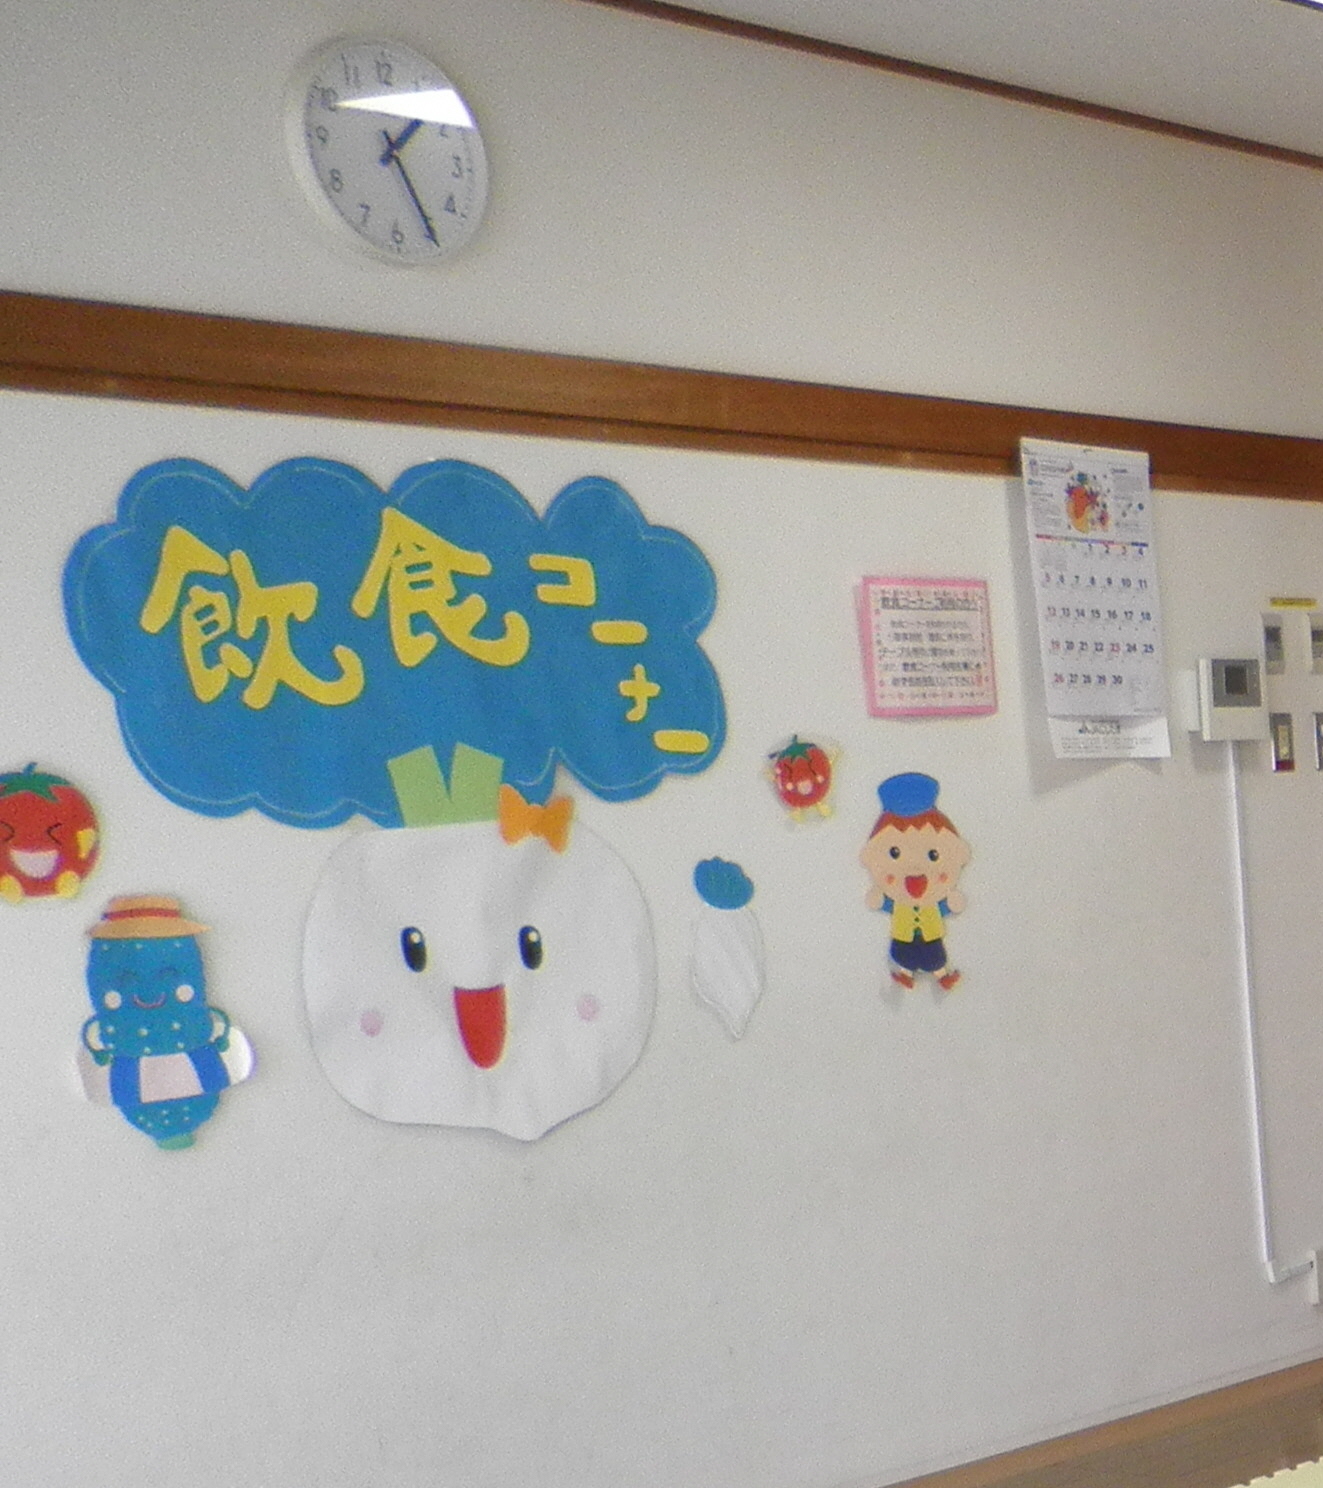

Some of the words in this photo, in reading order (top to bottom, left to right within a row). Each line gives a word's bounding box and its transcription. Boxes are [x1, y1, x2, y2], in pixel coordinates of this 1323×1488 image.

[375, 58, 394, 87] 12
[315, 124, 330, 144] 9
[451, 154, 464, 180] 3
[329, 168, 344, 193] 8
[359, 202, 372, 228] 7
[443, 194, 458, 215] 4
[390, 218, 404, 244] 6
[1121, 578, 1132, 588] 10
[1138, 579, 1148, 589] 11
[1047, 606, 1057, 617] 12
[1061, 607, 1070, 617] 13
[1075, 608, 1085, 618] 14
[1091, 609, 1101, 619] 15
[1107, 609, 1118, 619] 16
[1123, 610, 1134, 621] 17
[1140, 611, 1152, 621] 18
[139, 506, 711, 755] 飲食コーナー
[1065, 641, 1075, 651] 20
[1126, 643, 1137, 653] 24
[1143, 644, 1154, 654] 25
[1054, 673, 1065, 684] 26
[1069, 673, 1079, 684] 27
[1112, 675, 1123, 685] 30
